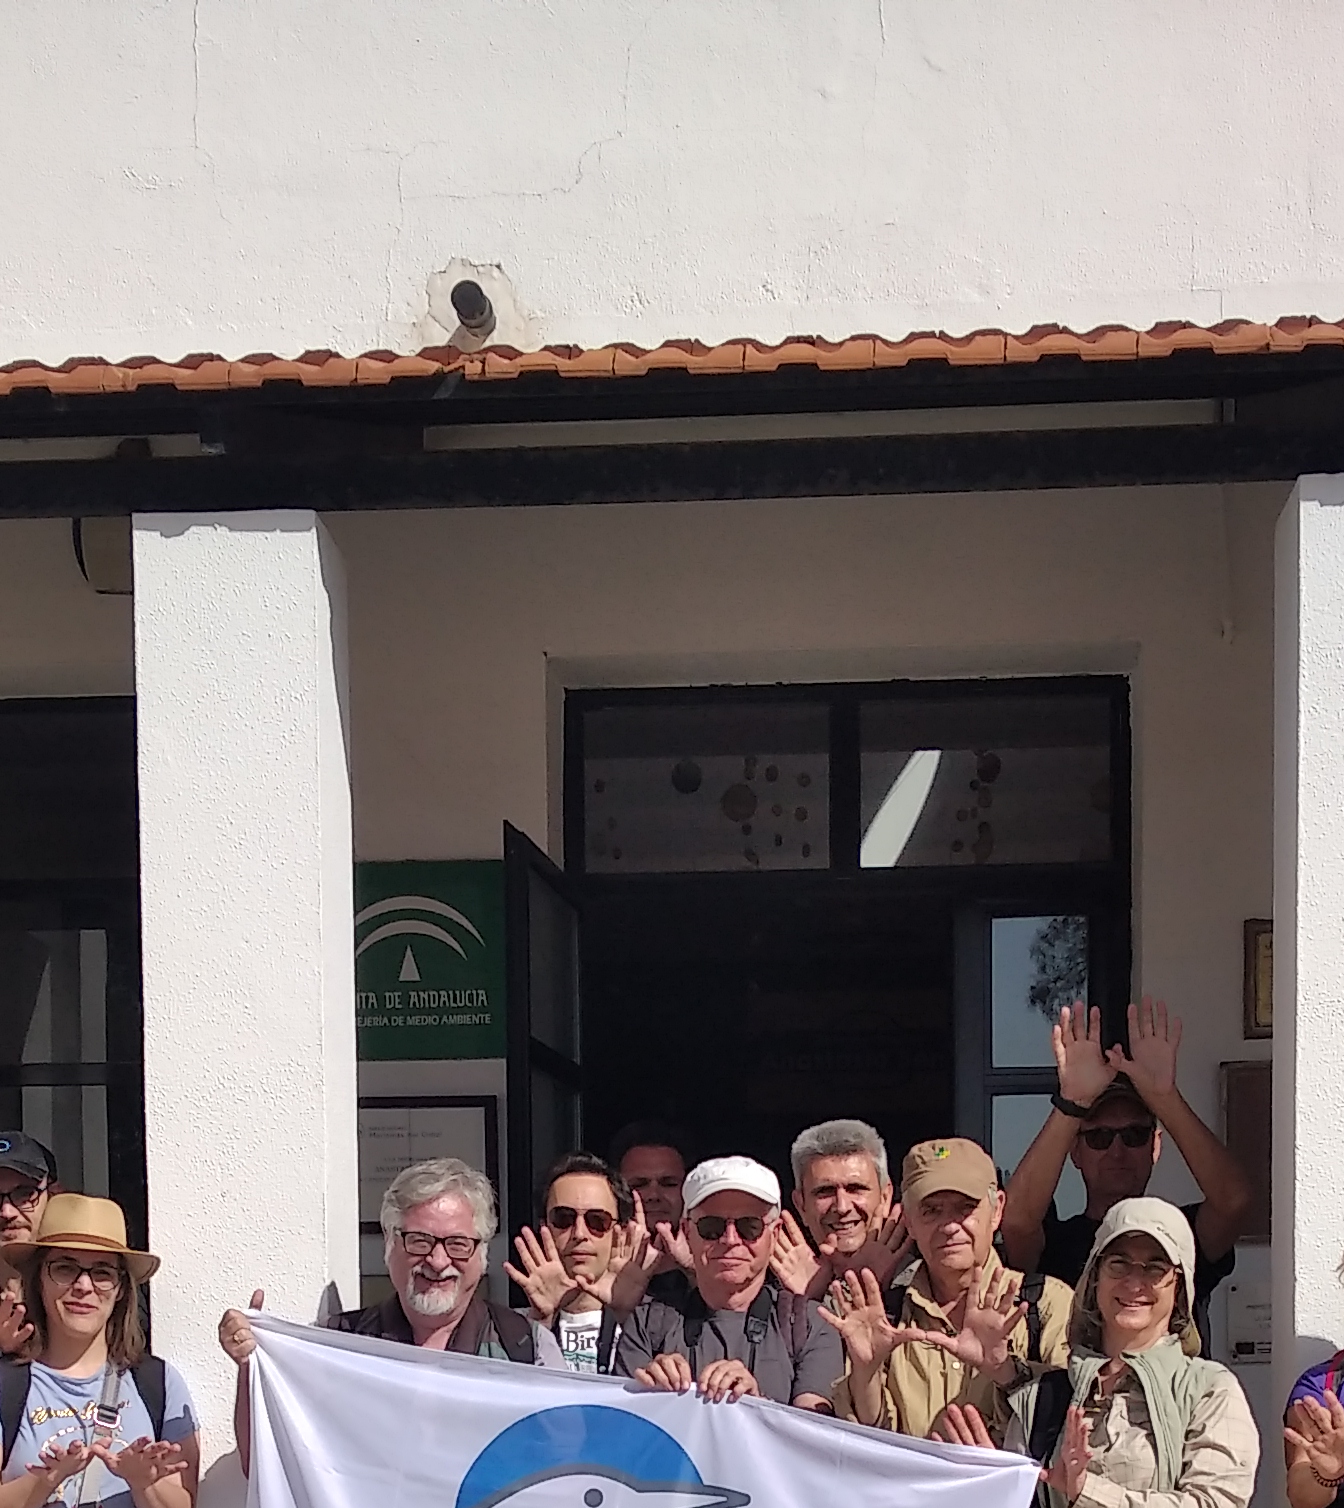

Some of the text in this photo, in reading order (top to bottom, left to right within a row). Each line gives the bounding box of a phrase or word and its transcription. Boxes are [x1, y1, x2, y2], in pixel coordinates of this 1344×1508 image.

[385, 991, 403, 1009] DE
[391, 1015, 405, 1027] DE
[406, 1014, 439, 1026] MEDIO
[440, 1013, 491, 1025] AMBIENTE
